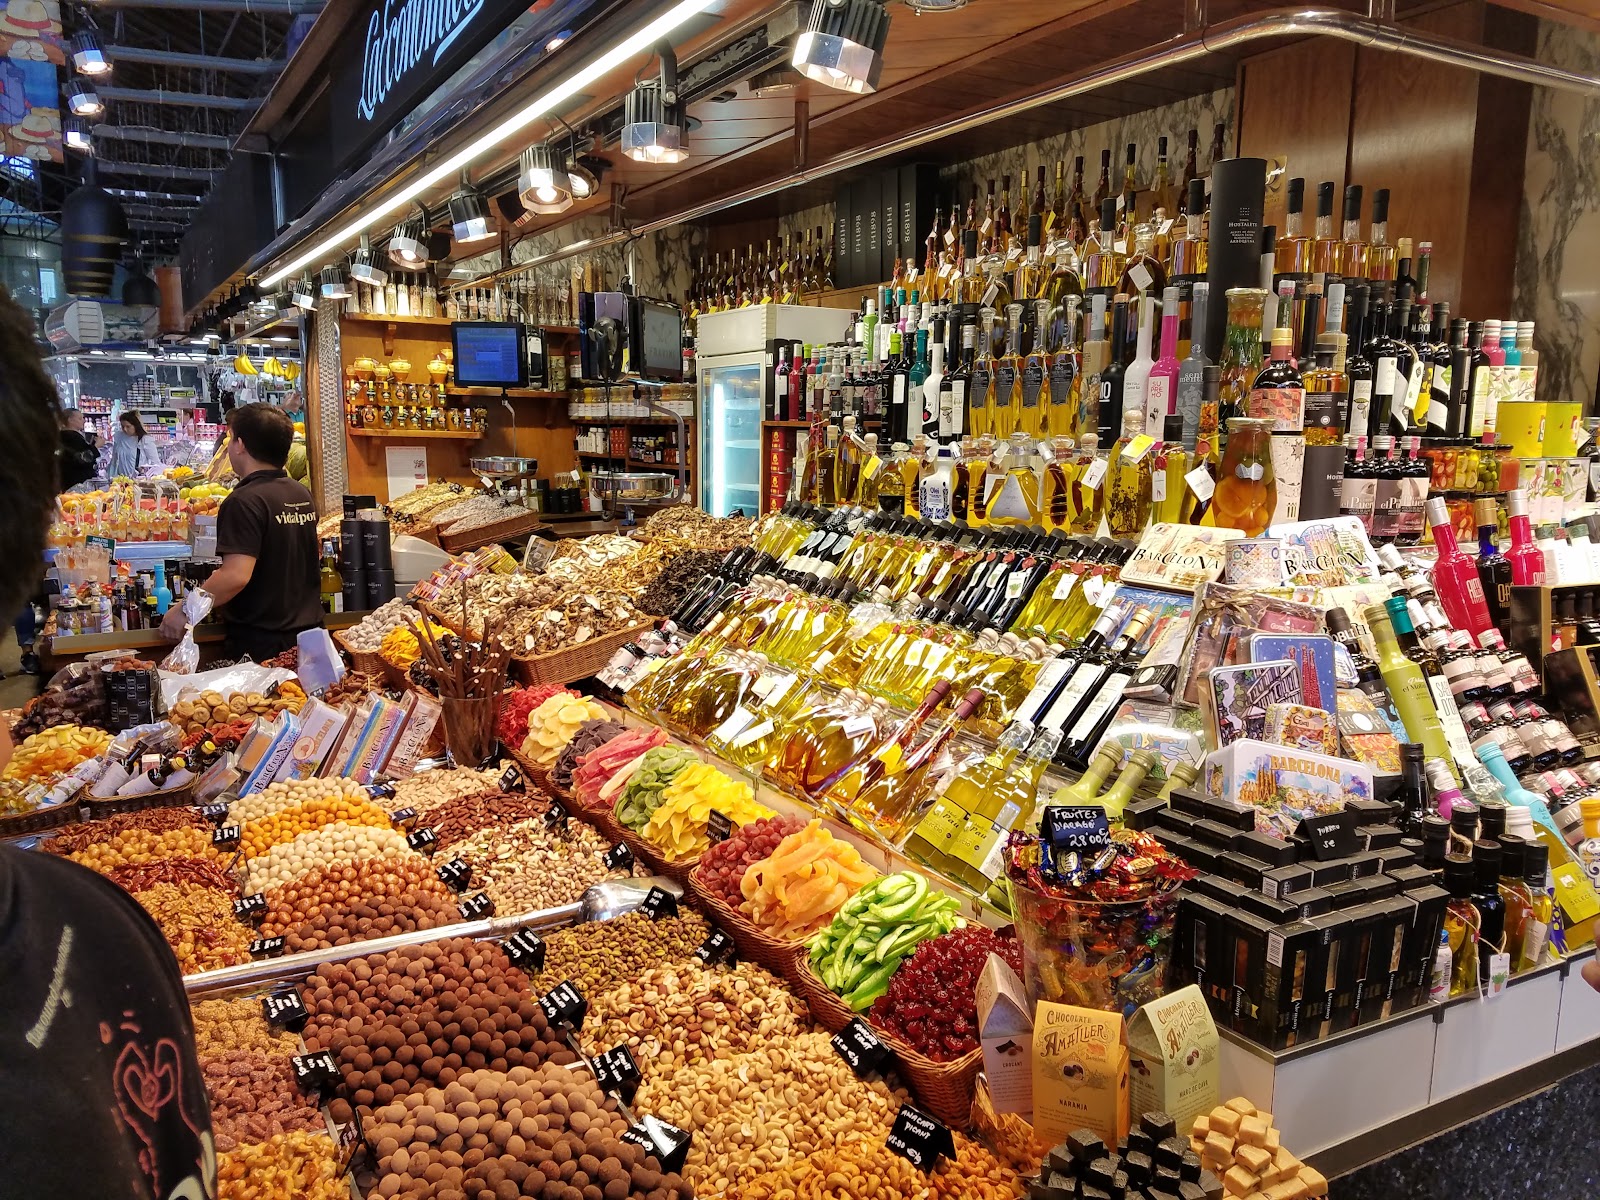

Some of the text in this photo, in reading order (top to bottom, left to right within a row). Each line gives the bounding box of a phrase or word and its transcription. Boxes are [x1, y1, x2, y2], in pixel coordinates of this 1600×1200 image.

[1270, 756, 1342, 784] BARCELONA
[1050, 808, 1098, 820] FRUITES
[1046, 1010, 1092, 1026] CHOCOLATE
[1157, 1000, 1186, 1025] CHOCOLATE
[1040, 1024, 1107, 1058] AMATLLER
[1059, 1098, 1088, 1112] NARANJA
[900, 1109, 936, 1130] ANACARD
[904, 1122, 931, 1140] PICANT
